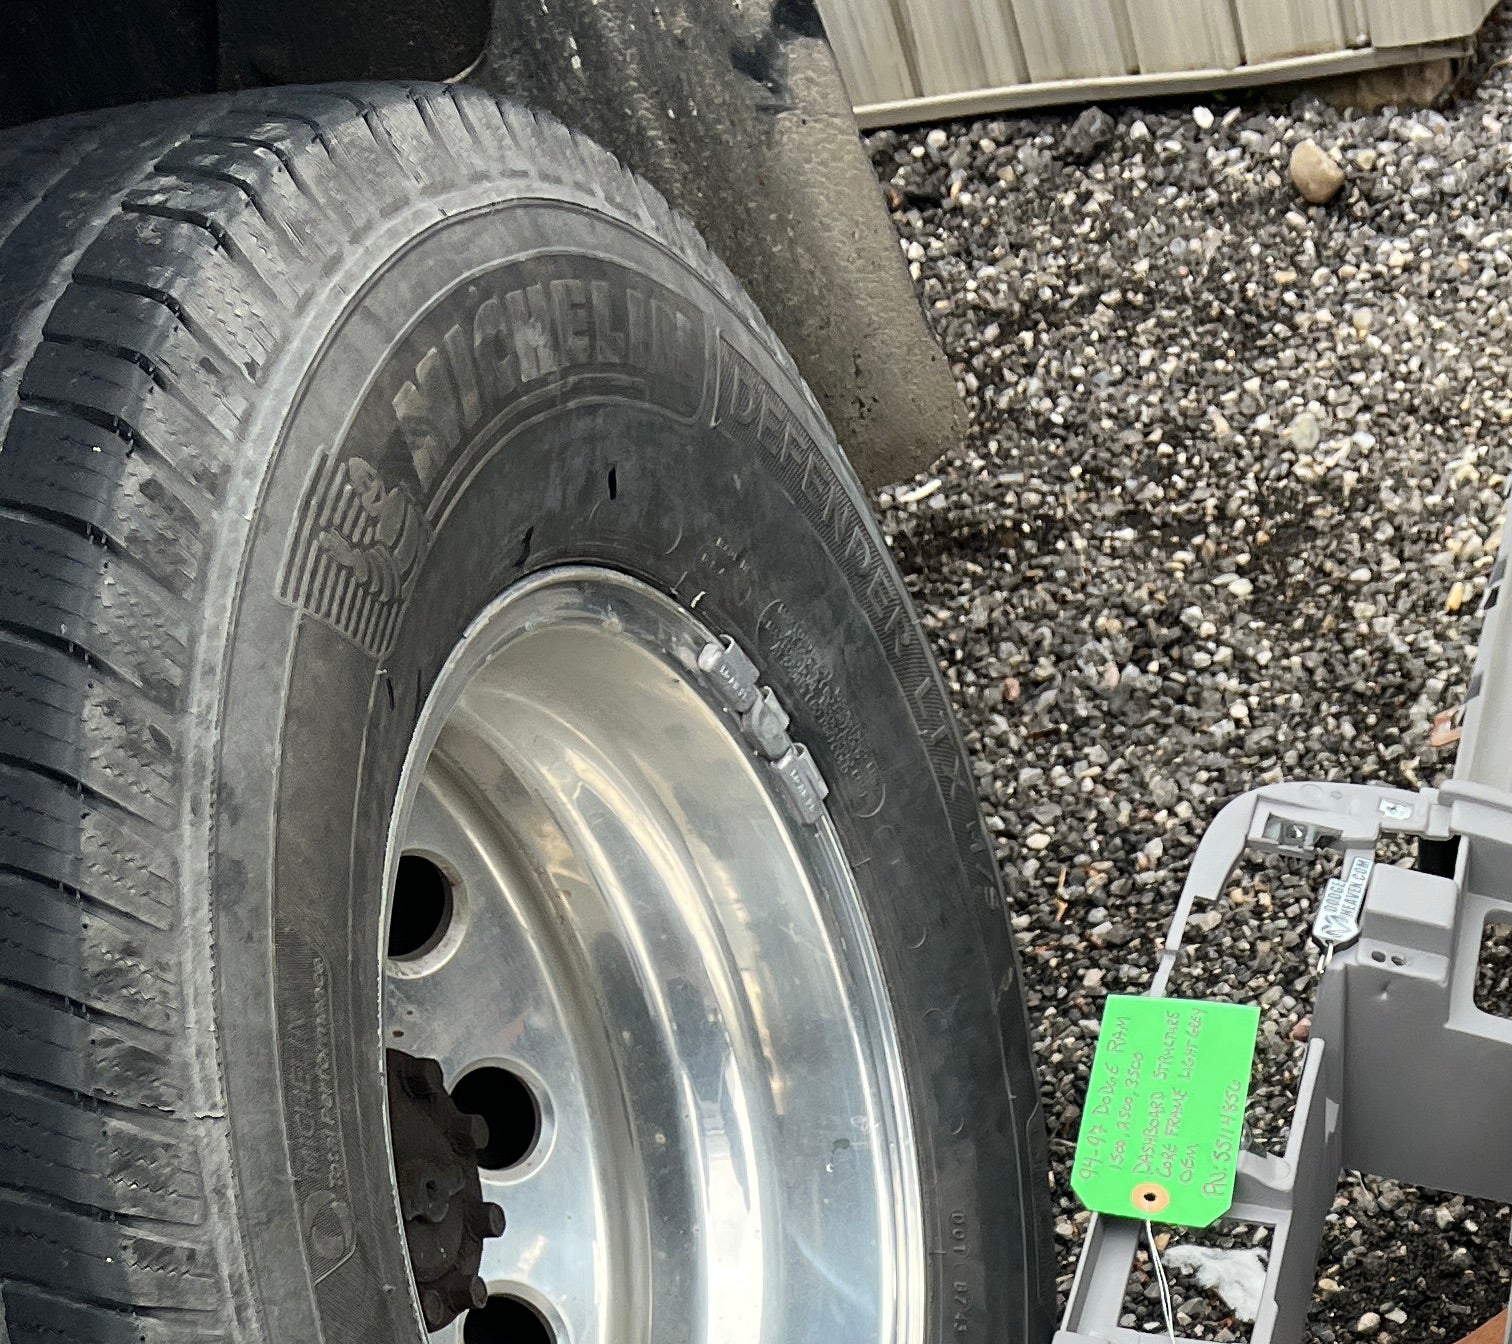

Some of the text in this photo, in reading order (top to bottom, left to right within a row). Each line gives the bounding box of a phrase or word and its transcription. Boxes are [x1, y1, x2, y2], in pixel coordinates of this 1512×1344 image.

[390, 277, 692, 494] MICHELIN
[725, 366, 916, 657] DEFENDER
[907, 677, 965, 802] LTX
[1323, 881, 1346, 912] DODGE
[1339, 859, 1370, 917] HEAVEN.COM
[1106, 1015, 1132, 1054] RAM
[1132, 1090, 1165, 1175] DASHBOARD
[1164, 1087, 1188, 1137] FRAME
[1156, 1143, 1178, 1180] CORE
[1179, 1143, 1200, 1184] OEM
